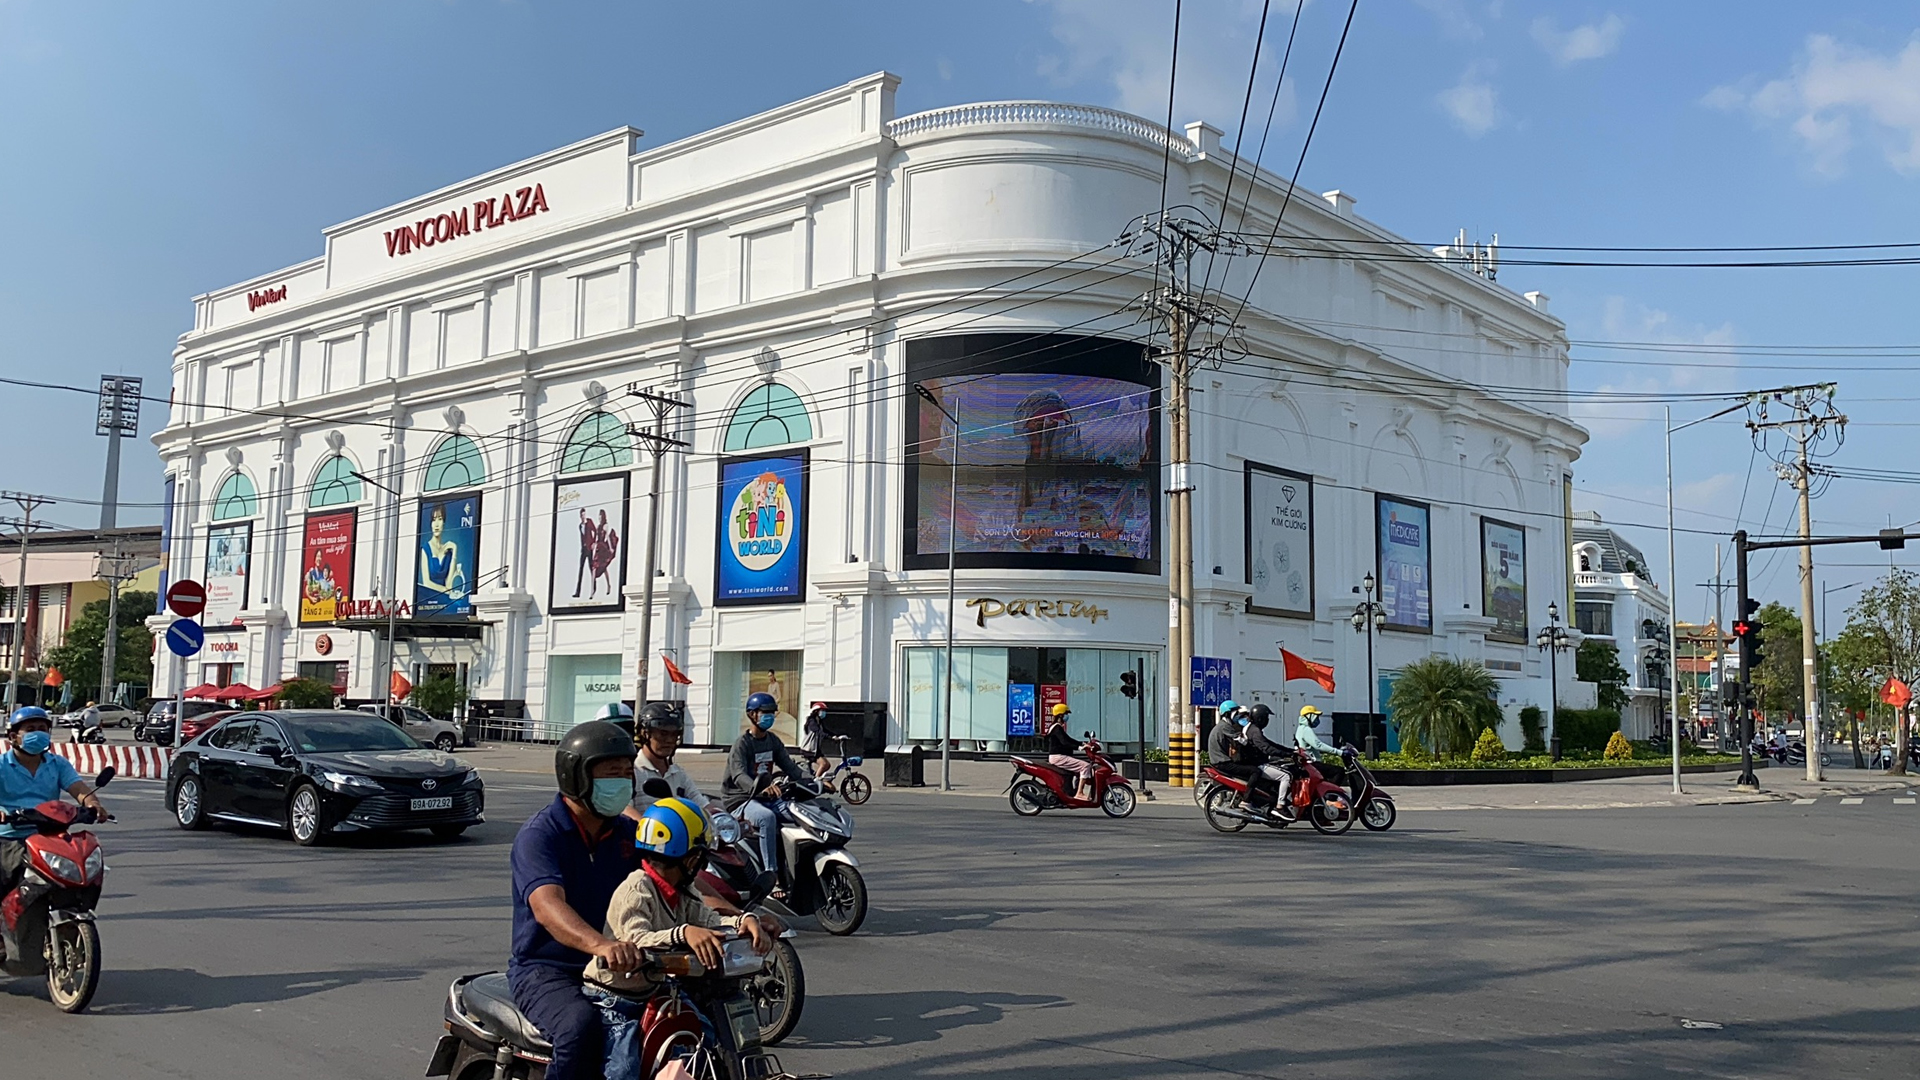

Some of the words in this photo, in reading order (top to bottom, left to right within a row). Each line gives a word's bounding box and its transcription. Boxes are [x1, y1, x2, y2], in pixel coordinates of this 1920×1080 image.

[383, 206, 470, 258] VINCOM
[473, 183, 550, 232] PLAZA
[247, 284, 287, 313] VinMart
[460, 516, 474, 529] PNJ
[1271, 517, 1284, 527] KIM
[1390, 523, 1420, 542] MEDICARE
[737, 539, 783, 557] WORLD
[1499, 550, 1509, 579] 5
[728, 586, 789, 595] www.tiniworld.com
[318, 608, 322, 616] 2
[210, 642, 239, 652] TOOCHA
[584, 683, 621, 693] VASCARA
